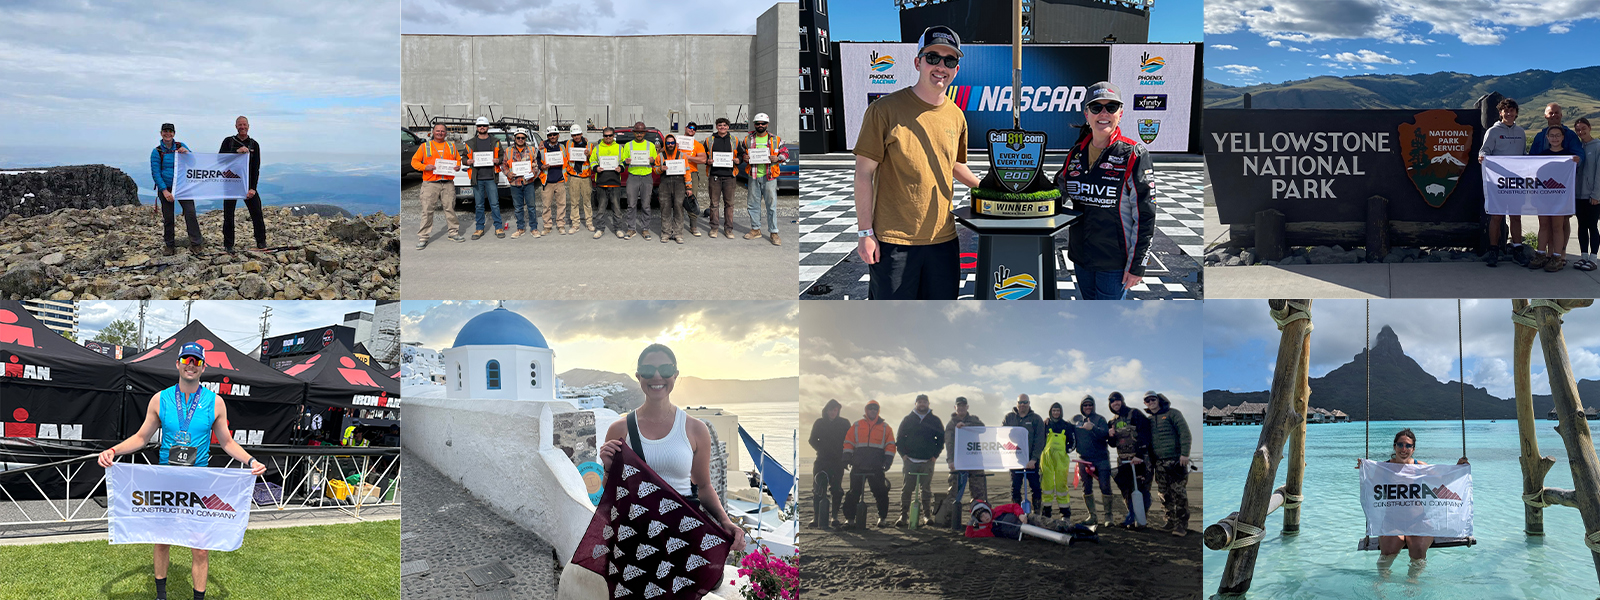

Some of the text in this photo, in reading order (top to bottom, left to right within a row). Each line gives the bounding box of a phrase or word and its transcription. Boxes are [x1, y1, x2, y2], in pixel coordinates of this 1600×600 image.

[821, 38, 825, 52] 1
[824, 76, 828, 91] 1
[978, 86, 1088, 112] NASCAR
[1138, 98, 1162, 108] xfinity
[801, 115, 808, 130] 1
[827, 115, 831, 129] 1
[1211, 132, 1391, 153] YELLOWSTONE
[1242, 156, 1366, 176] NATIONAL
[186, 169, 225, 179] SIERRA
[1004, 172, 1030, 180] 200
[1066, 180, 1117, 197] DRIVE
[1271, 178, 1338, 199] PARK
[1497, 177, 1547, 190] SIERRA
[996, 203, 1033, 211] WINNER
[198, 378, 250, 397] ONMAN
[966, 442, 1006, 451] SIERRA
[178, 452, 188, 460] 40
[637, 485, 661, 497] SIERRA
[1373, 483, 1438, 501] SIERRA
[132, 490, 207, 509] SIERRA
[1373, 500, 1464, 508] CONSTRUCTION COMPANY
[132, 506, 237, 520] CONSTRUCTION COMPANY
[659, 501, 682, 515] SIERRA
[679, 519, 704, 532] SIERRA
[700, 537, 726, 551] SIERRA
[636, 546, 659, 560] SIERRA
[686, 558, 711, 571] SIERRA
[623, 568, 646, 581] SIERRA
